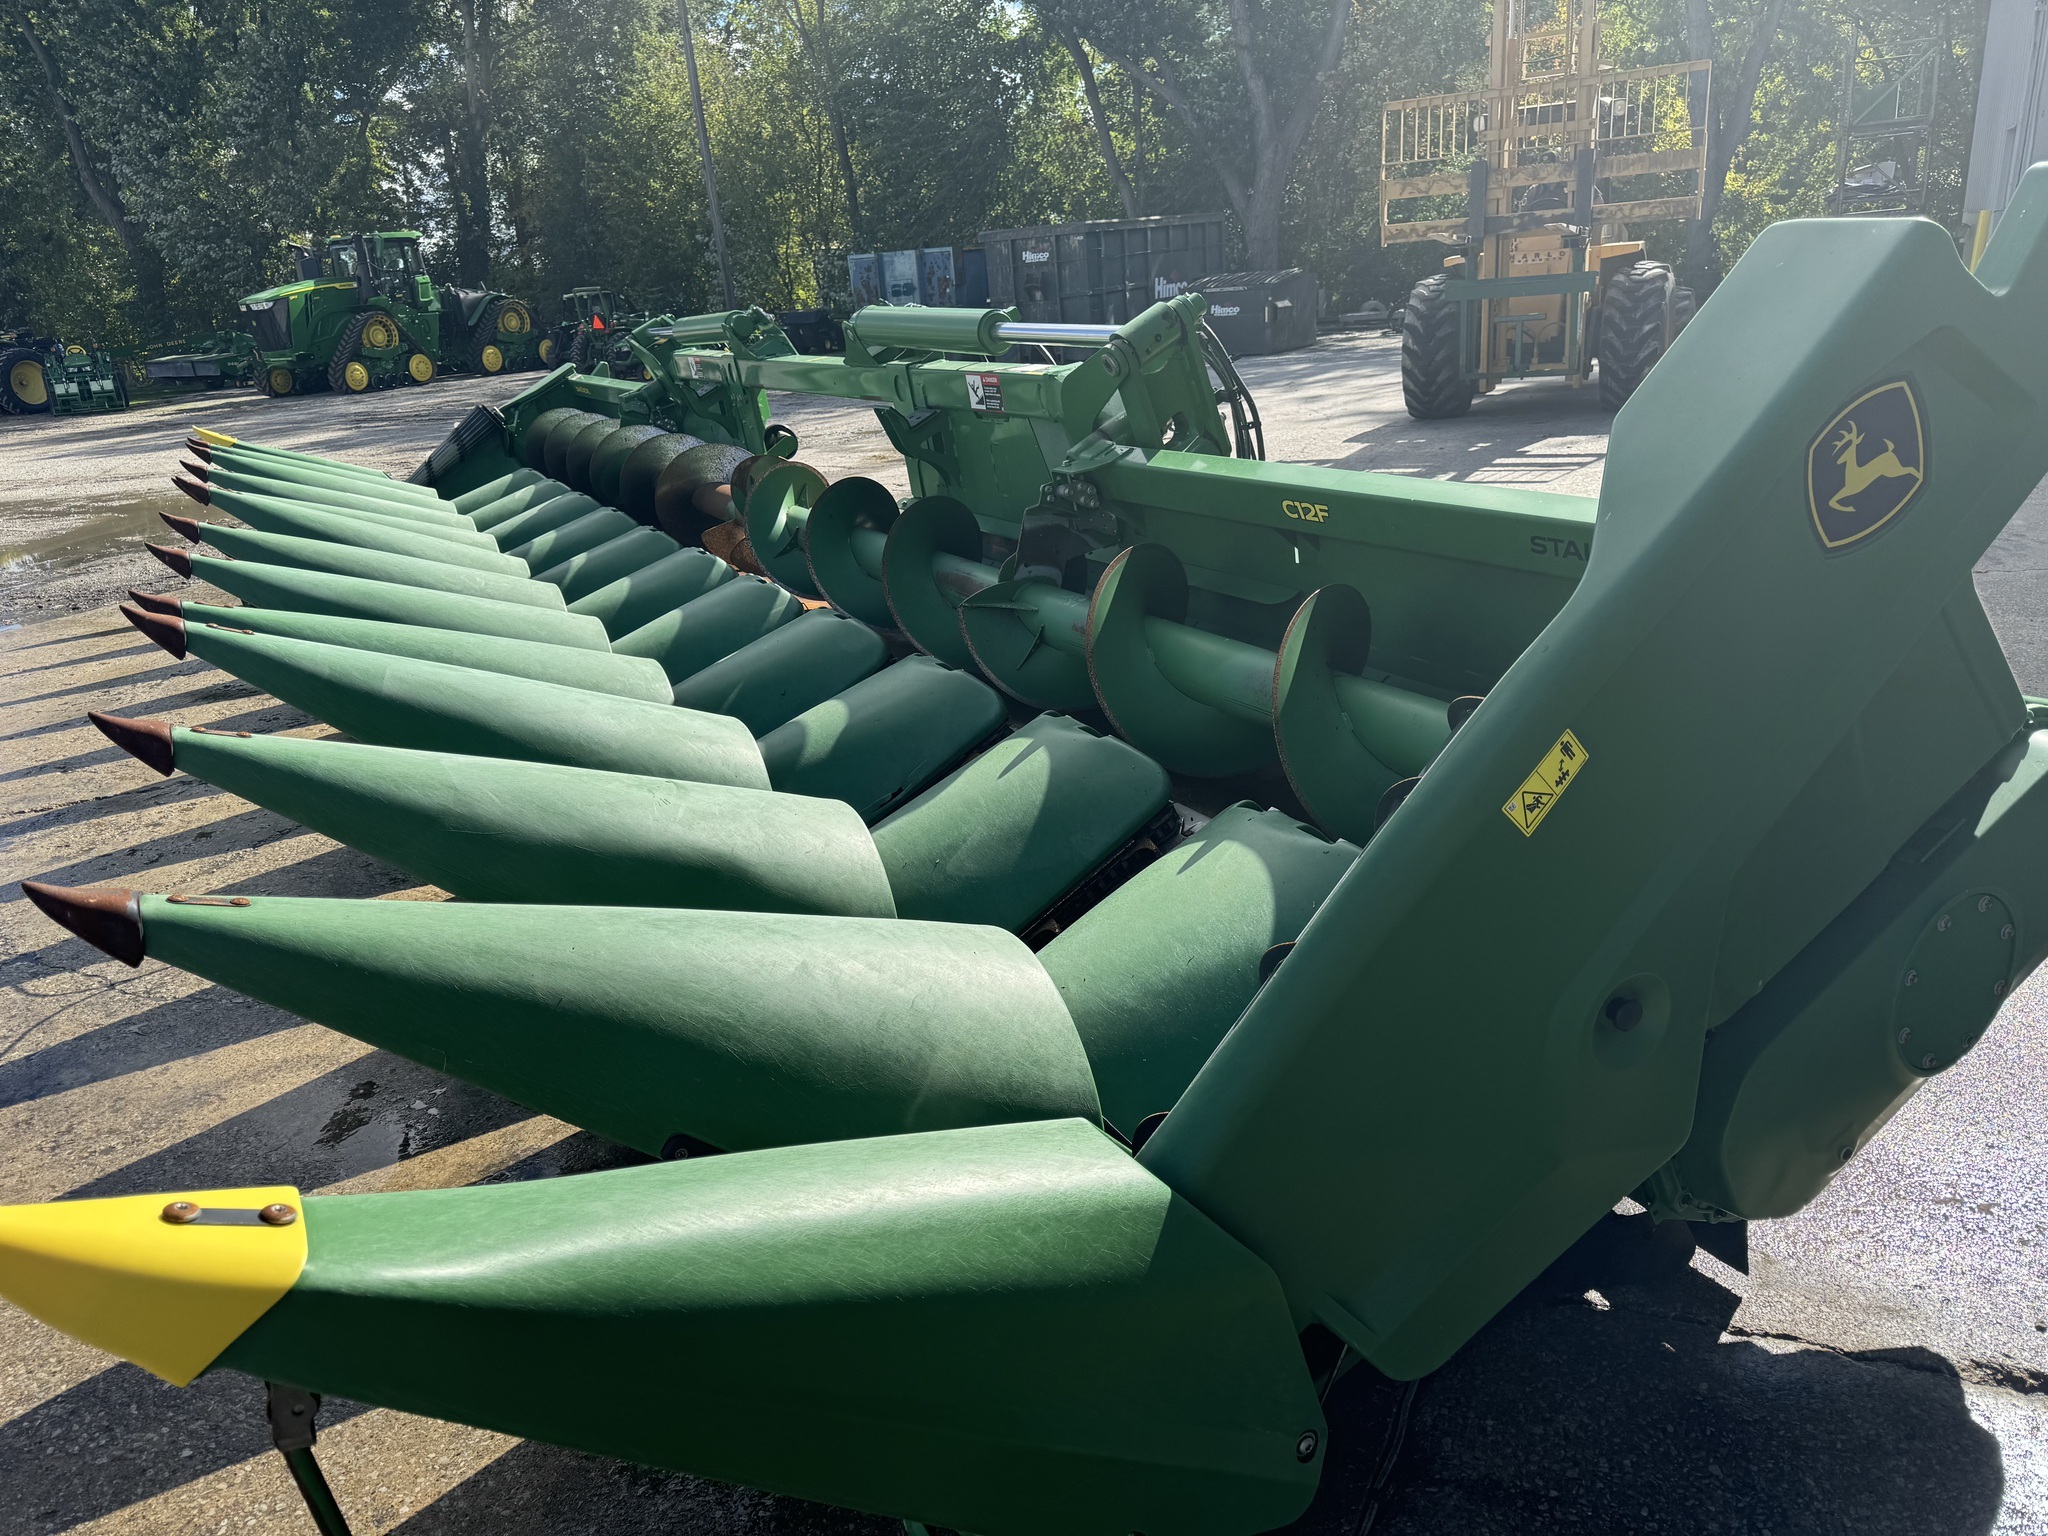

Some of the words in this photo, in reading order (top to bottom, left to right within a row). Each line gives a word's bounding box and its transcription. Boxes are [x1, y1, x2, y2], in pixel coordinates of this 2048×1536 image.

[1022, 251, 1049, 261] Himco
[1510, 250, 1566, 260] HARLO
[1210, 304, 1240, 315] Himco
[1281, 499, 1329, 523] C12F
